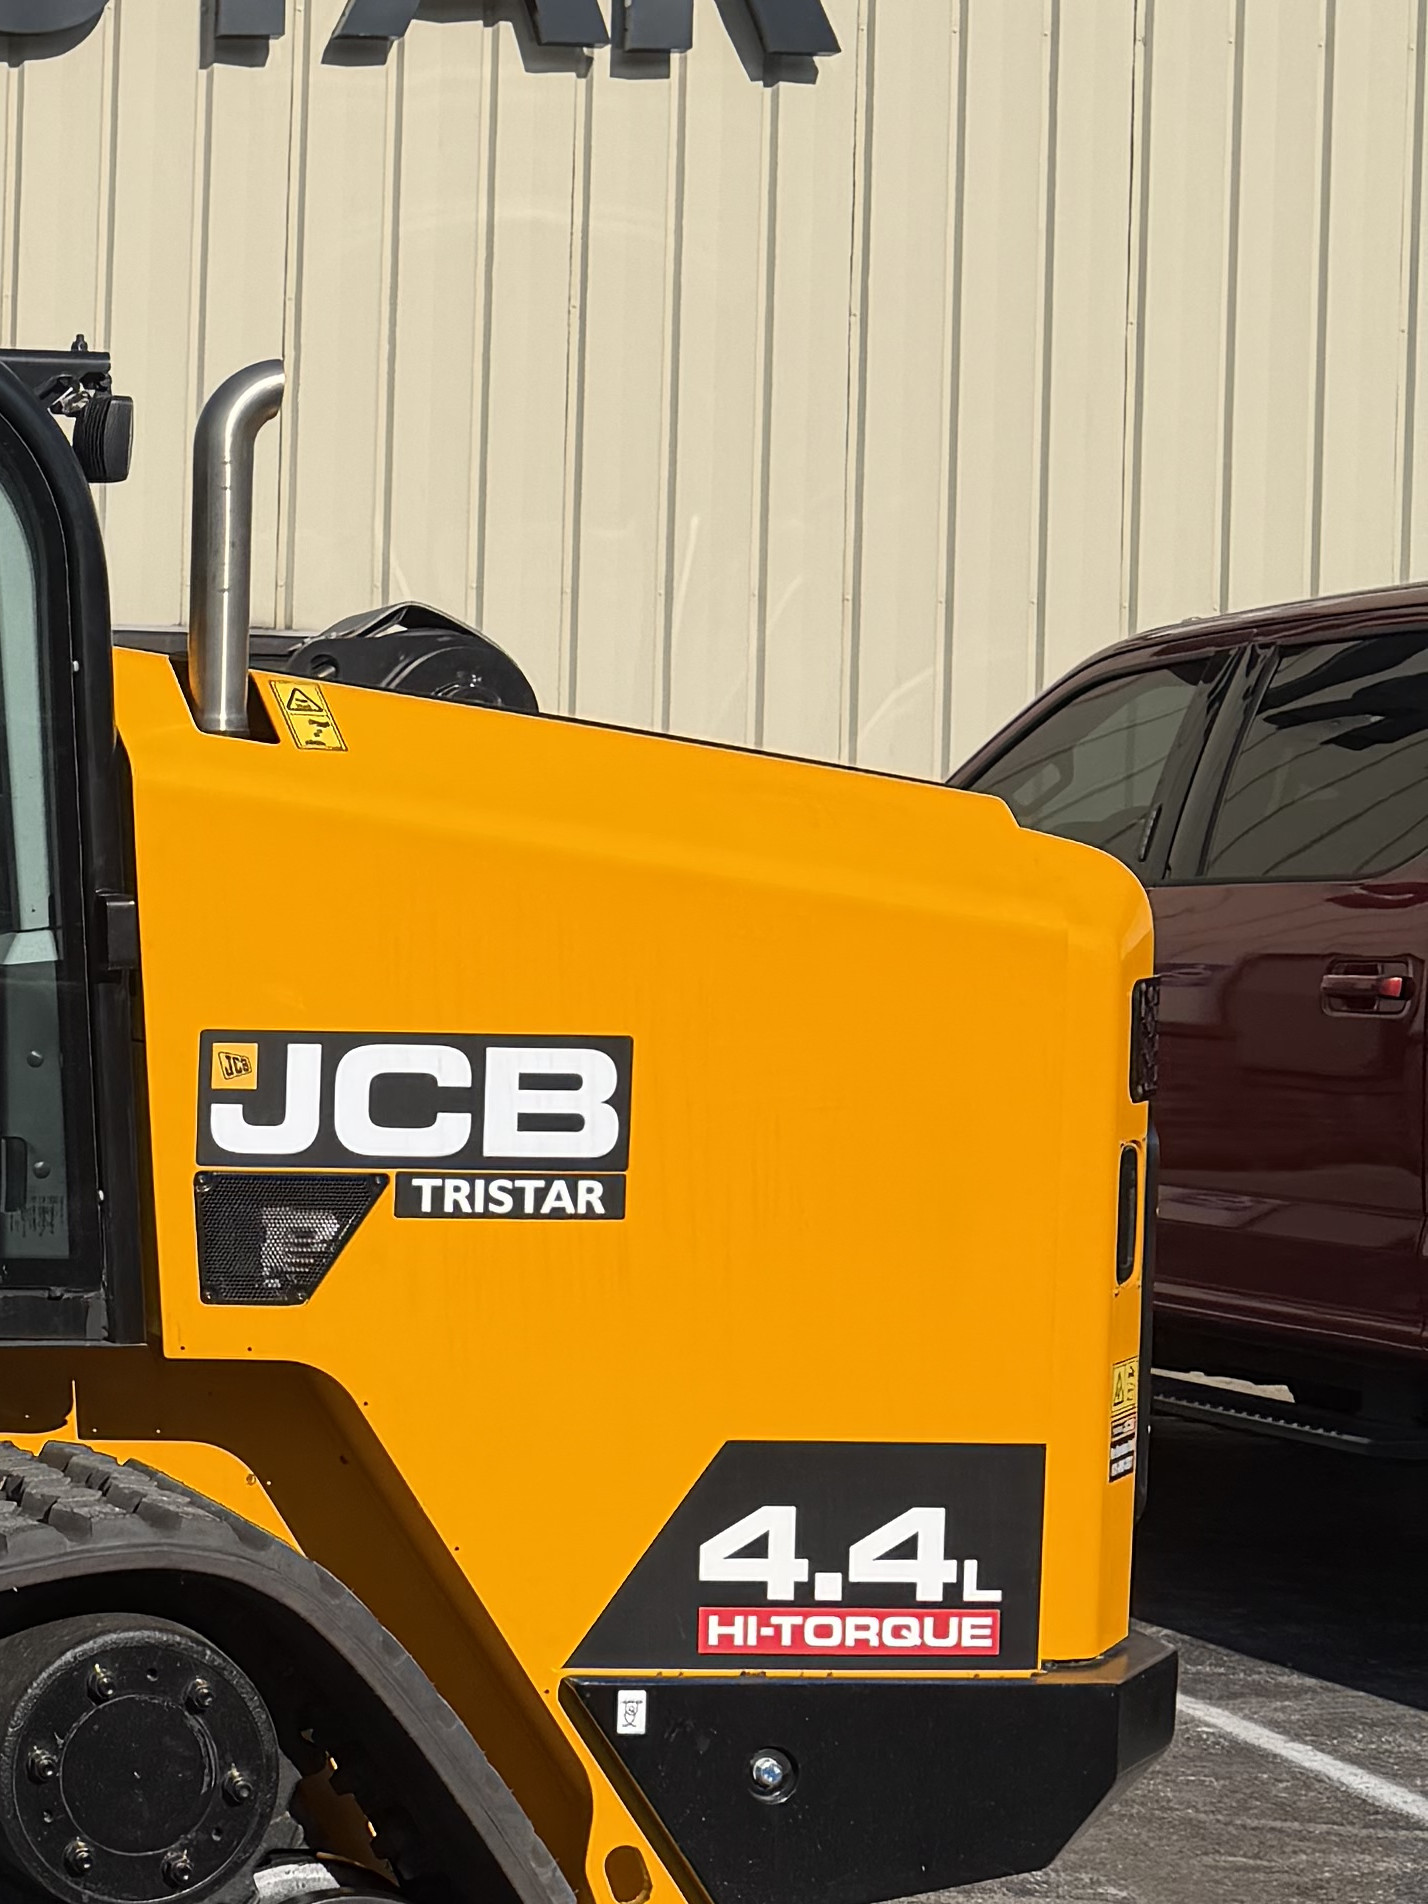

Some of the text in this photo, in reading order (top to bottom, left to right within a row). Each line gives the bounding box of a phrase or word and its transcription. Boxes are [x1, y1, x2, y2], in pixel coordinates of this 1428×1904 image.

[224, 1055, 249, 1077] JCB
[210, 1042, 619, 1158] JCB
[411, 1178, 606, 1215] TRISTAR
[699, 1505, 1003, 1602] 4.4L
[707, 1614, 994, 1648] HI-TORQUE
